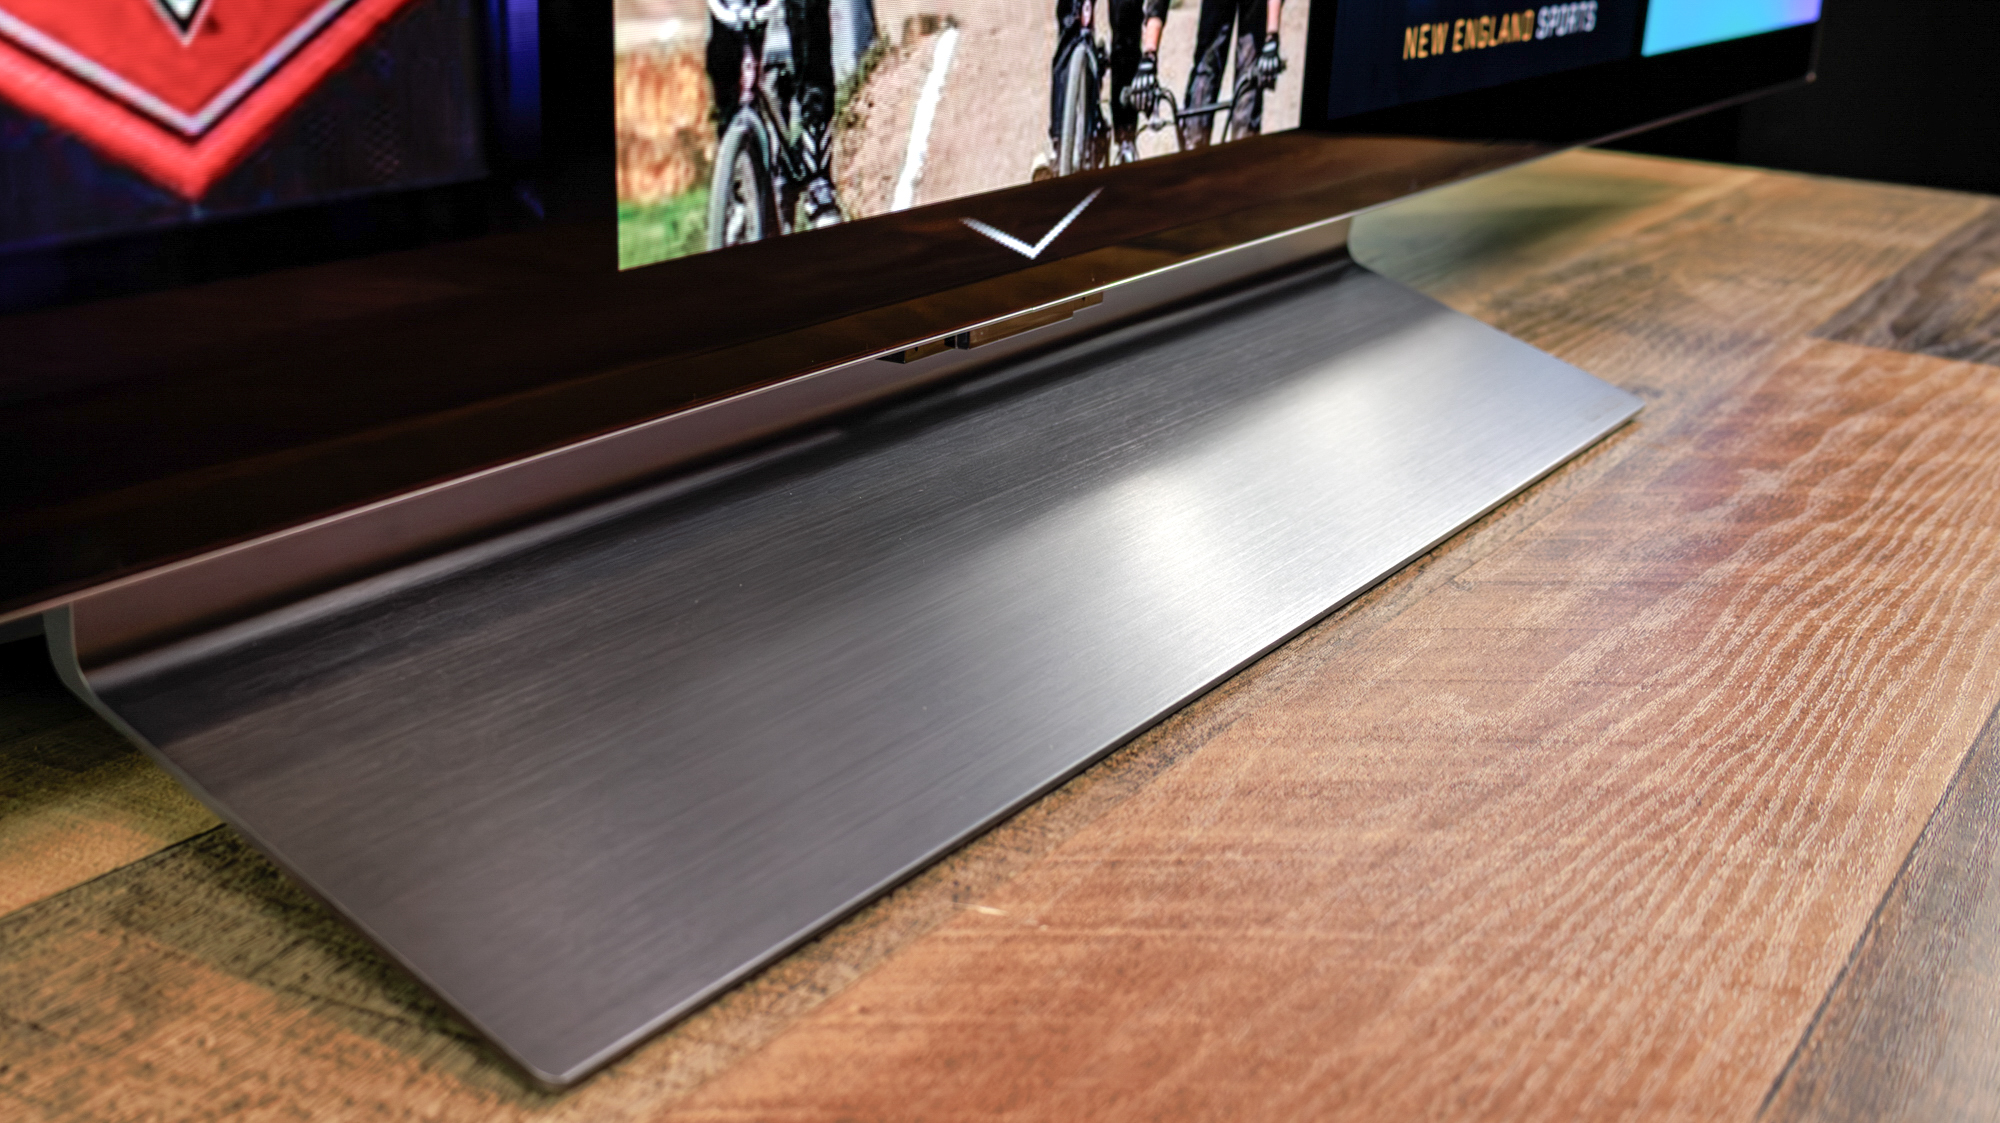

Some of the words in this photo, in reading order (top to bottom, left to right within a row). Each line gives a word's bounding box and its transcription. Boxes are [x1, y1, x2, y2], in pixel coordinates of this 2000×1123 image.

[1402, 22, 1449, 61] NEW
[1451, 9, 1535, 53] ENGLAND
[1535, 0, 1598, 40] SPORTS
